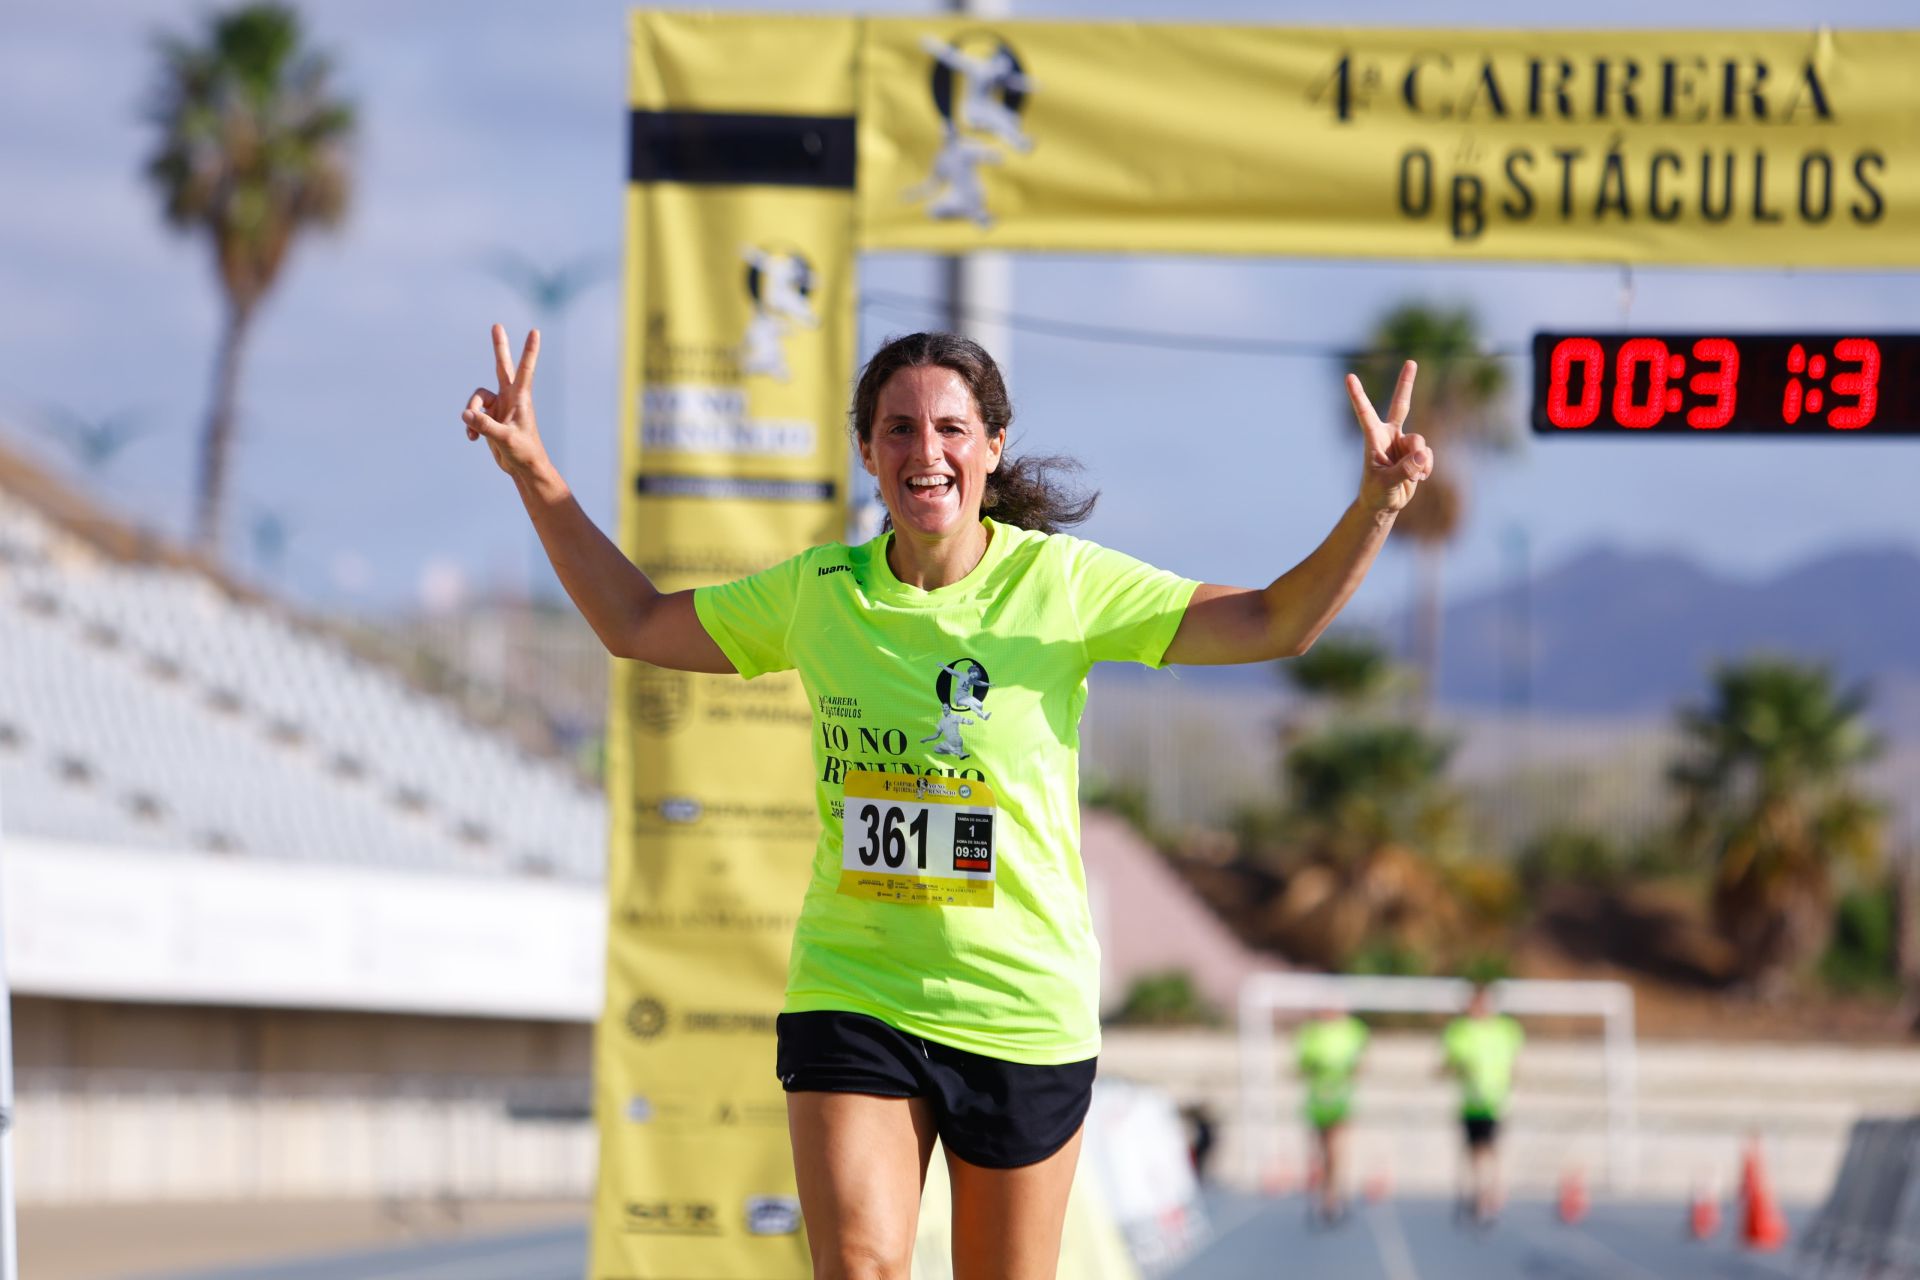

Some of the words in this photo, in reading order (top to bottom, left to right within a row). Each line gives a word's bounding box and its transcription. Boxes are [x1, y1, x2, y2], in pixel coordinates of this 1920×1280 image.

[1400, 52, 1836, 124] CARRERA
[1399, 132, 1886, 242] OBSTÁCULOS
[821, 721, 849, 752] YO
[858, 727, 908, 756] NO
[858, 804, 929, 869] 361
[955, 846, 988, 859] 09:30
[968, 824, 975, 838] 1
